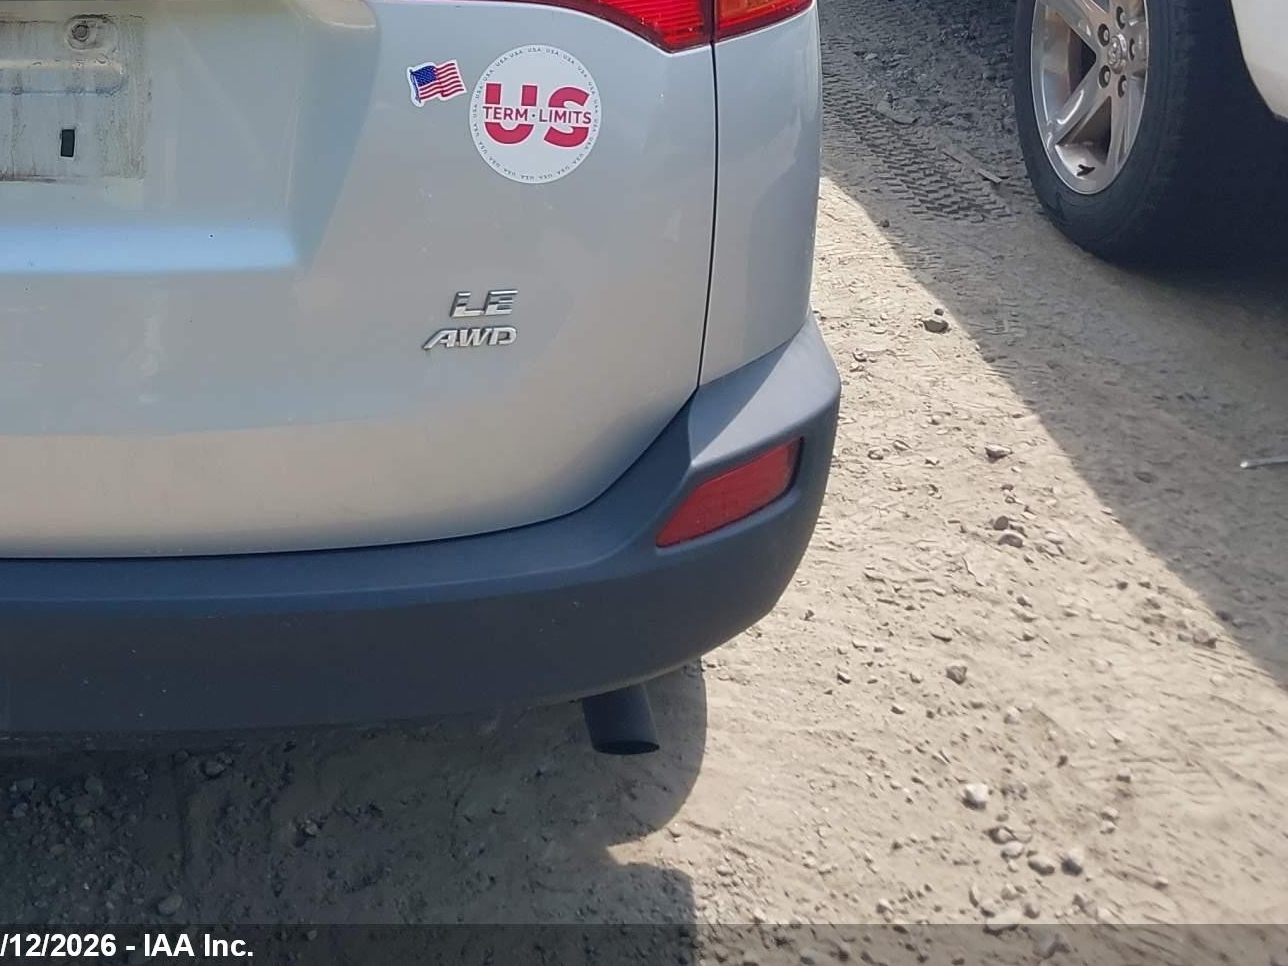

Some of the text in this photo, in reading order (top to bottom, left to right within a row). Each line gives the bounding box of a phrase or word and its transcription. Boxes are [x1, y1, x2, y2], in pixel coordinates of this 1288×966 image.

[483, 106, 592, 124] TERM LIMITS
[484, 83, 590, 148] US
[449, 289, 518, 317] LE
[422, 325, 518, 350] AWD
